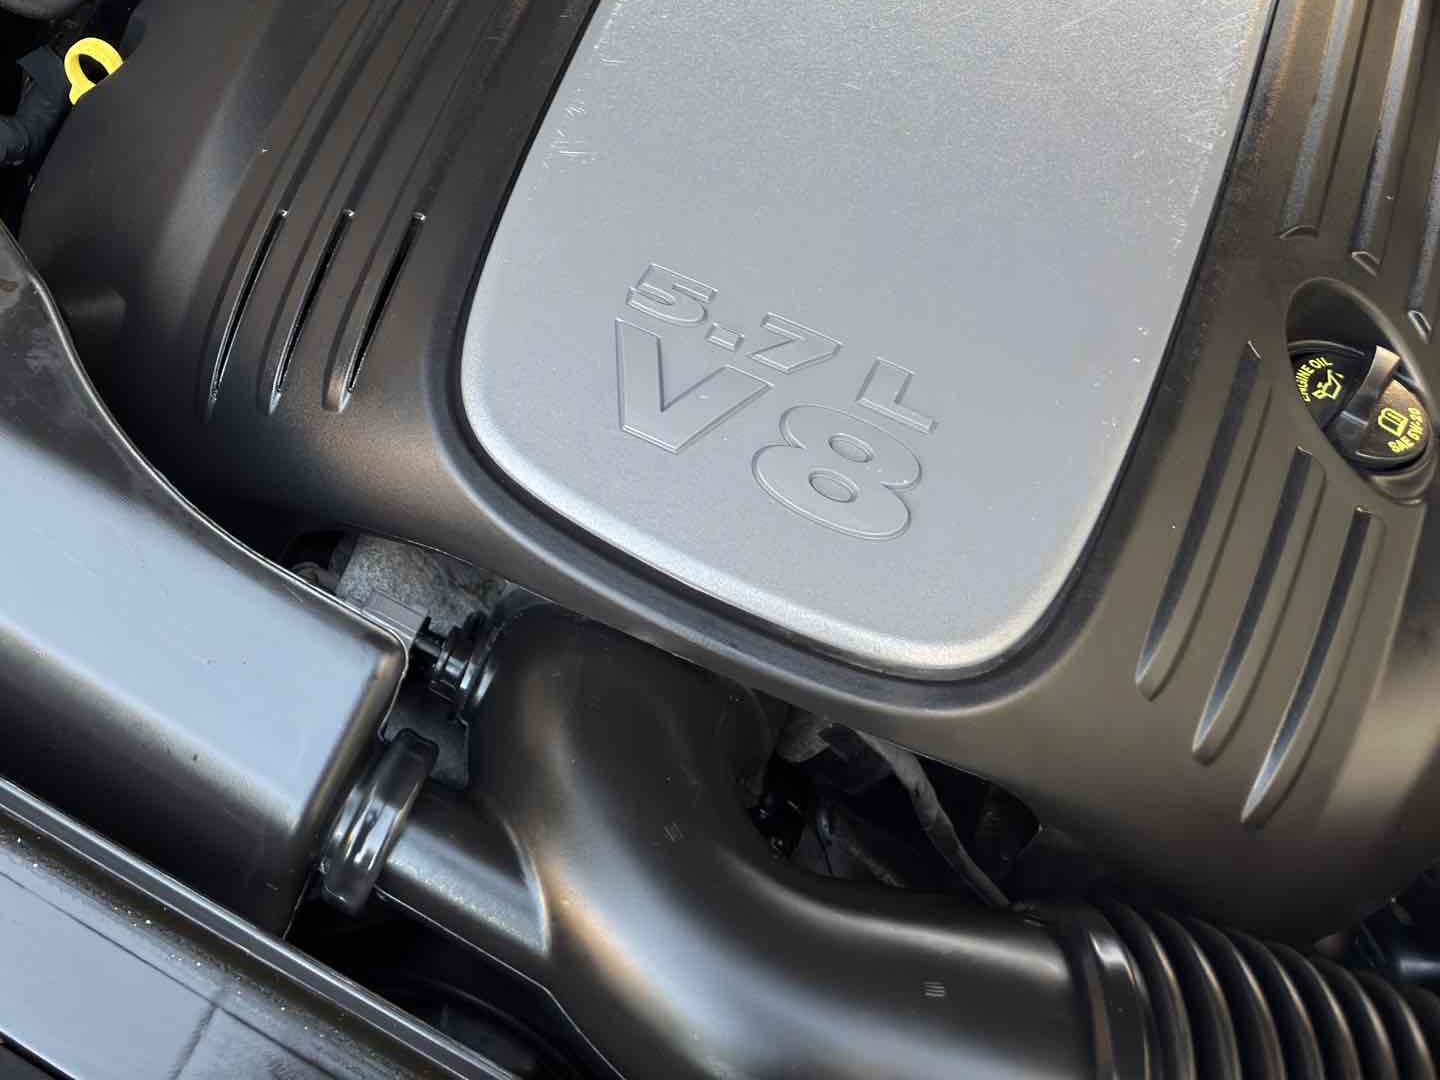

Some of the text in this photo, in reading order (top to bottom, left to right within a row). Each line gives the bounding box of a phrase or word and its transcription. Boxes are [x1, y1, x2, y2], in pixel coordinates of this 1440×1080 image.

[625, 262, 939, 435] 5.7L
[1308, 357, 1333, 369] OIL
[614, 316, 922, 541] V8
[1387, 436, 1415, 453] SAE
